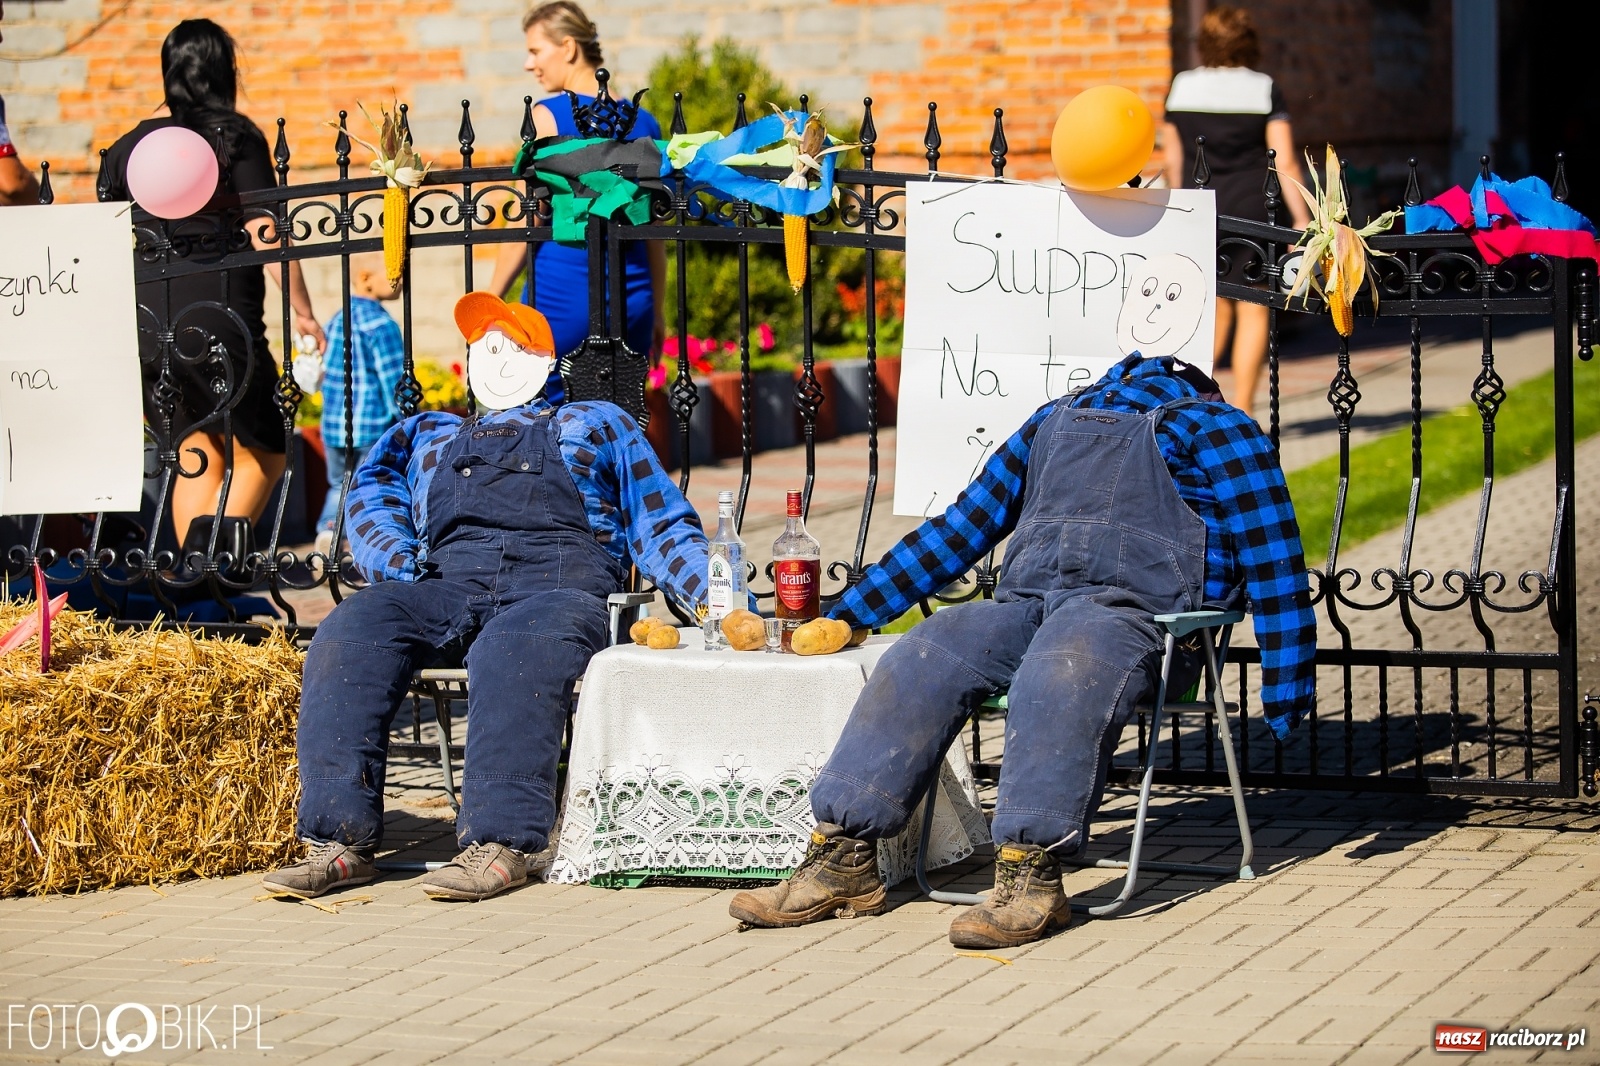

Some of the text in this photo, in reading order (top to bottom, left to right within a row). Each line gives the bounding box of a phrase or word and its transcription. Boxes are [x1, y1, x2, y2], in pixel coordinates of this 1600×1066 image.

[939, 333, 1010, 399] Na
[10, 368, 59, 390] na
[780, 571, 811, 585] Grant's
